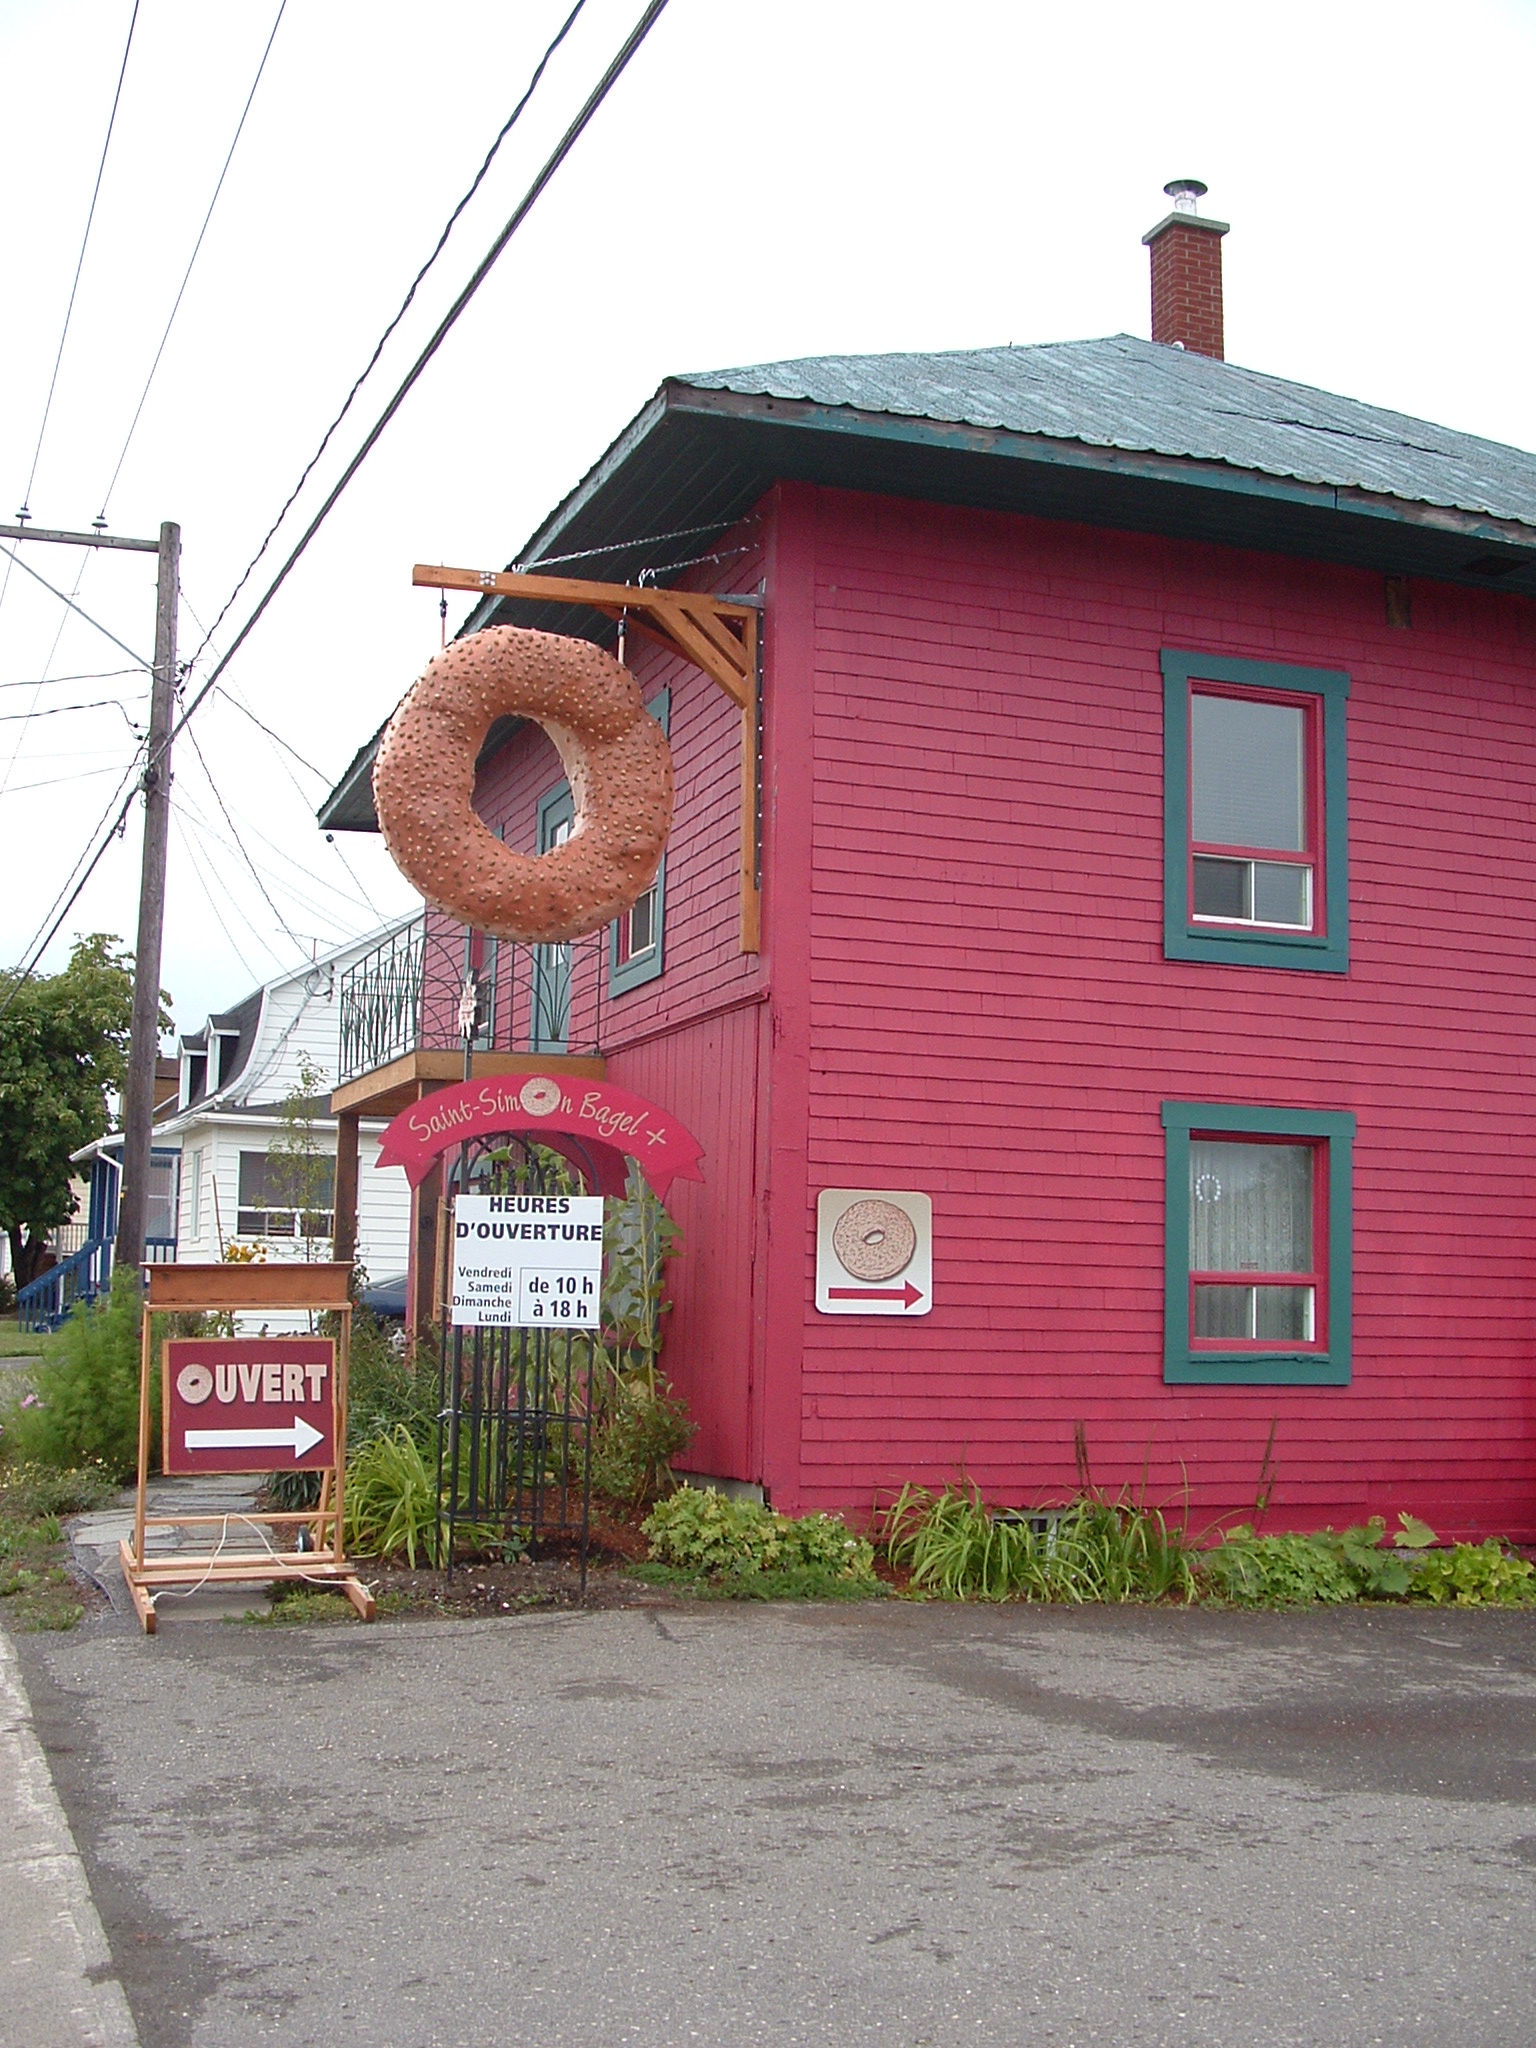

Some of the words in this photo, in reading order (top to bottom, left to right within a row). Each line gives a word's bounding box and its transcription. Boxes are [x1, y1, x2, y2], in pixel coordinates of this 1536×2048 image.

[579, 1092, 649, 1137] Bagel
[489, 1197, 570, 1214] HEURES
[458, 1266, 512, 1279] Vendredi
[468, 1281, 512, 1293] Samedi
[529, 1277, 549, 1294] de
[556, 1277, 577, 1294] 10
[583, 1276, 593, 1294] h
[453, 1296, 512, 1308] Dimanche
[533, 1299, 543, 1317] à
[550, 1300, 571, 1318] 18
[577, 1300, 588, 1318] h
[478, 1312, 511, 1322] Lundi
[176, 1363, 328, 1404] OUVERT
